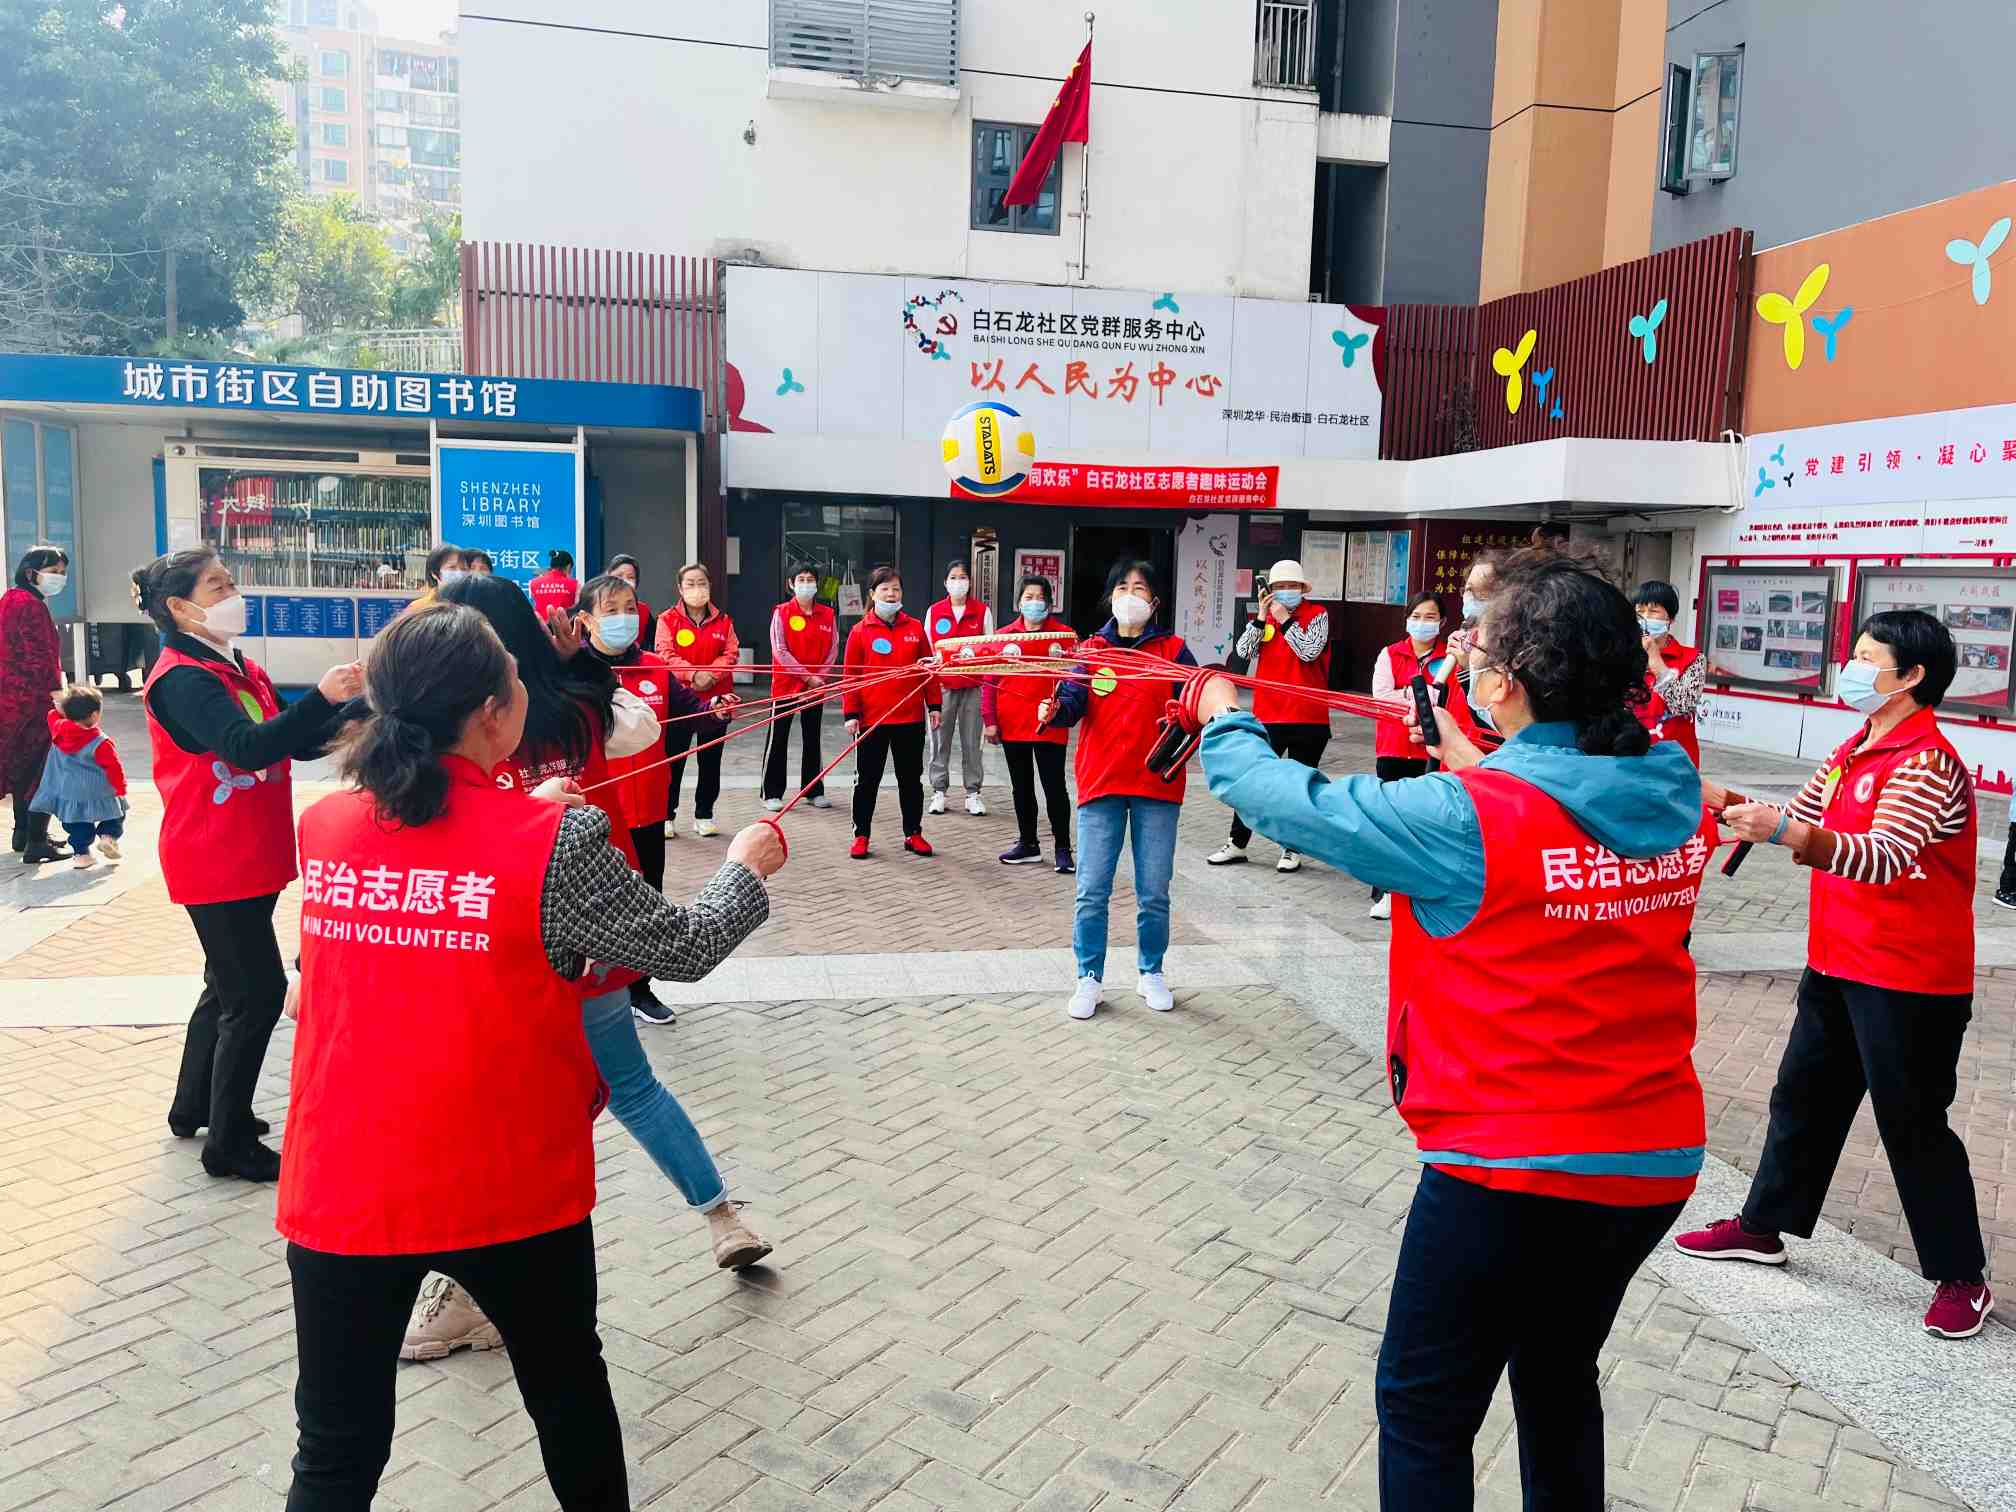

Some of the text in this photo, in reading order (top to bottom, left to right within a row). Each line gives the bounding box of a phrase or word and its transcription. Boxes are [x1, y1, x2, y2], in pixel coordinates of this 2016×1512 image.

[973, 308, 1205, 342] 白石龙社区党群服务中心
[1008, 336, 1034, 345] LONG
[1037, 338, 1054, 347] SHE
[1057, 339, 1071, 348] QU
[1073, 340, 1099, 350] DANG
[1101, 341, 1121, 351] QUN
[1124, 342, 1136, 352] FU
[1138, 343, 1153, 352] WU
[1155, 344, 1188, 354] ZHONG
[1190, 346, 1205, 354] XIN
[123, 361, 518, 417] 城市街区自助图书馆
[970, 358, 1222, 406] 以人民为中心
[979, 416, 995, 475] STADATS
[460, 480, 541, 496] SHENZHEN
[1086, 471, 1268, 490] 白石龙社区志愿者趣味运动会
[462, 497, 541, 513] LIBRARY
[462, 514, 540, 528] 深圳图书馆
[303, 858, 496, 920] 民治志愿者
[1544, 885, 1696, 921] MIN ZHI VOLUNTEER
[302, 914, 490, 952] MIN ZHI VOLUNTEER
